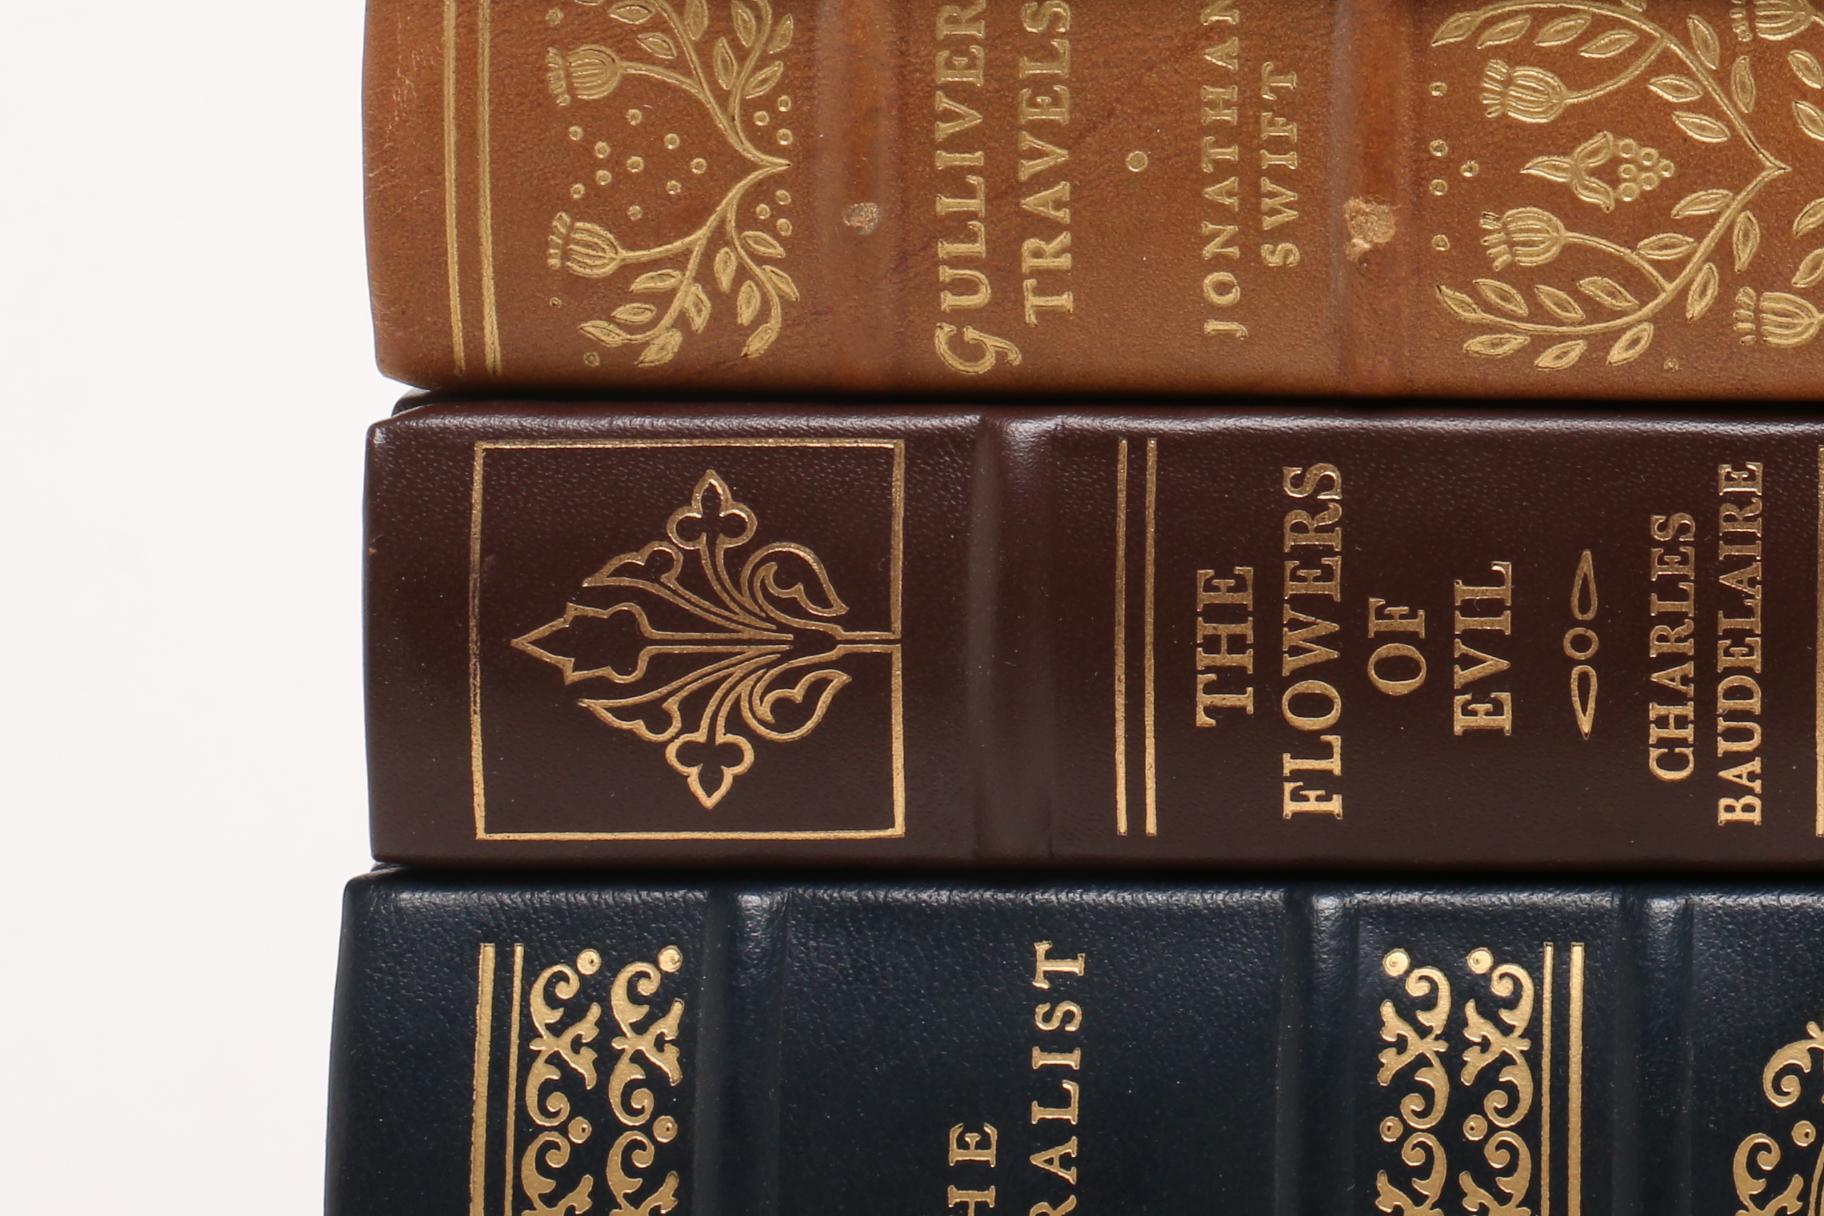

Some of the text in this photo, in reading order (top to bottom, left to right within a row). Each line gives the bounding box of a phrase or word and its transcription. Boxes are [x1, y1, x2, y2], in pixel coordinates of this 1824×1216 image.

[1018, 0, 1073, 326] TRAVELS
[1260, 61, 1300, 268] SWIFT
[1195, 566, 1254, 728] THE
[1282, 462, 1343, 820] FLOWERS
[1367, 597, 1427, 696] OF
[1453, 560, 1512, 737] EVIL
[1648, 511, 1696, 783] CHARLES
[1717, 461, 1764, 827] BAUDELAIRE
